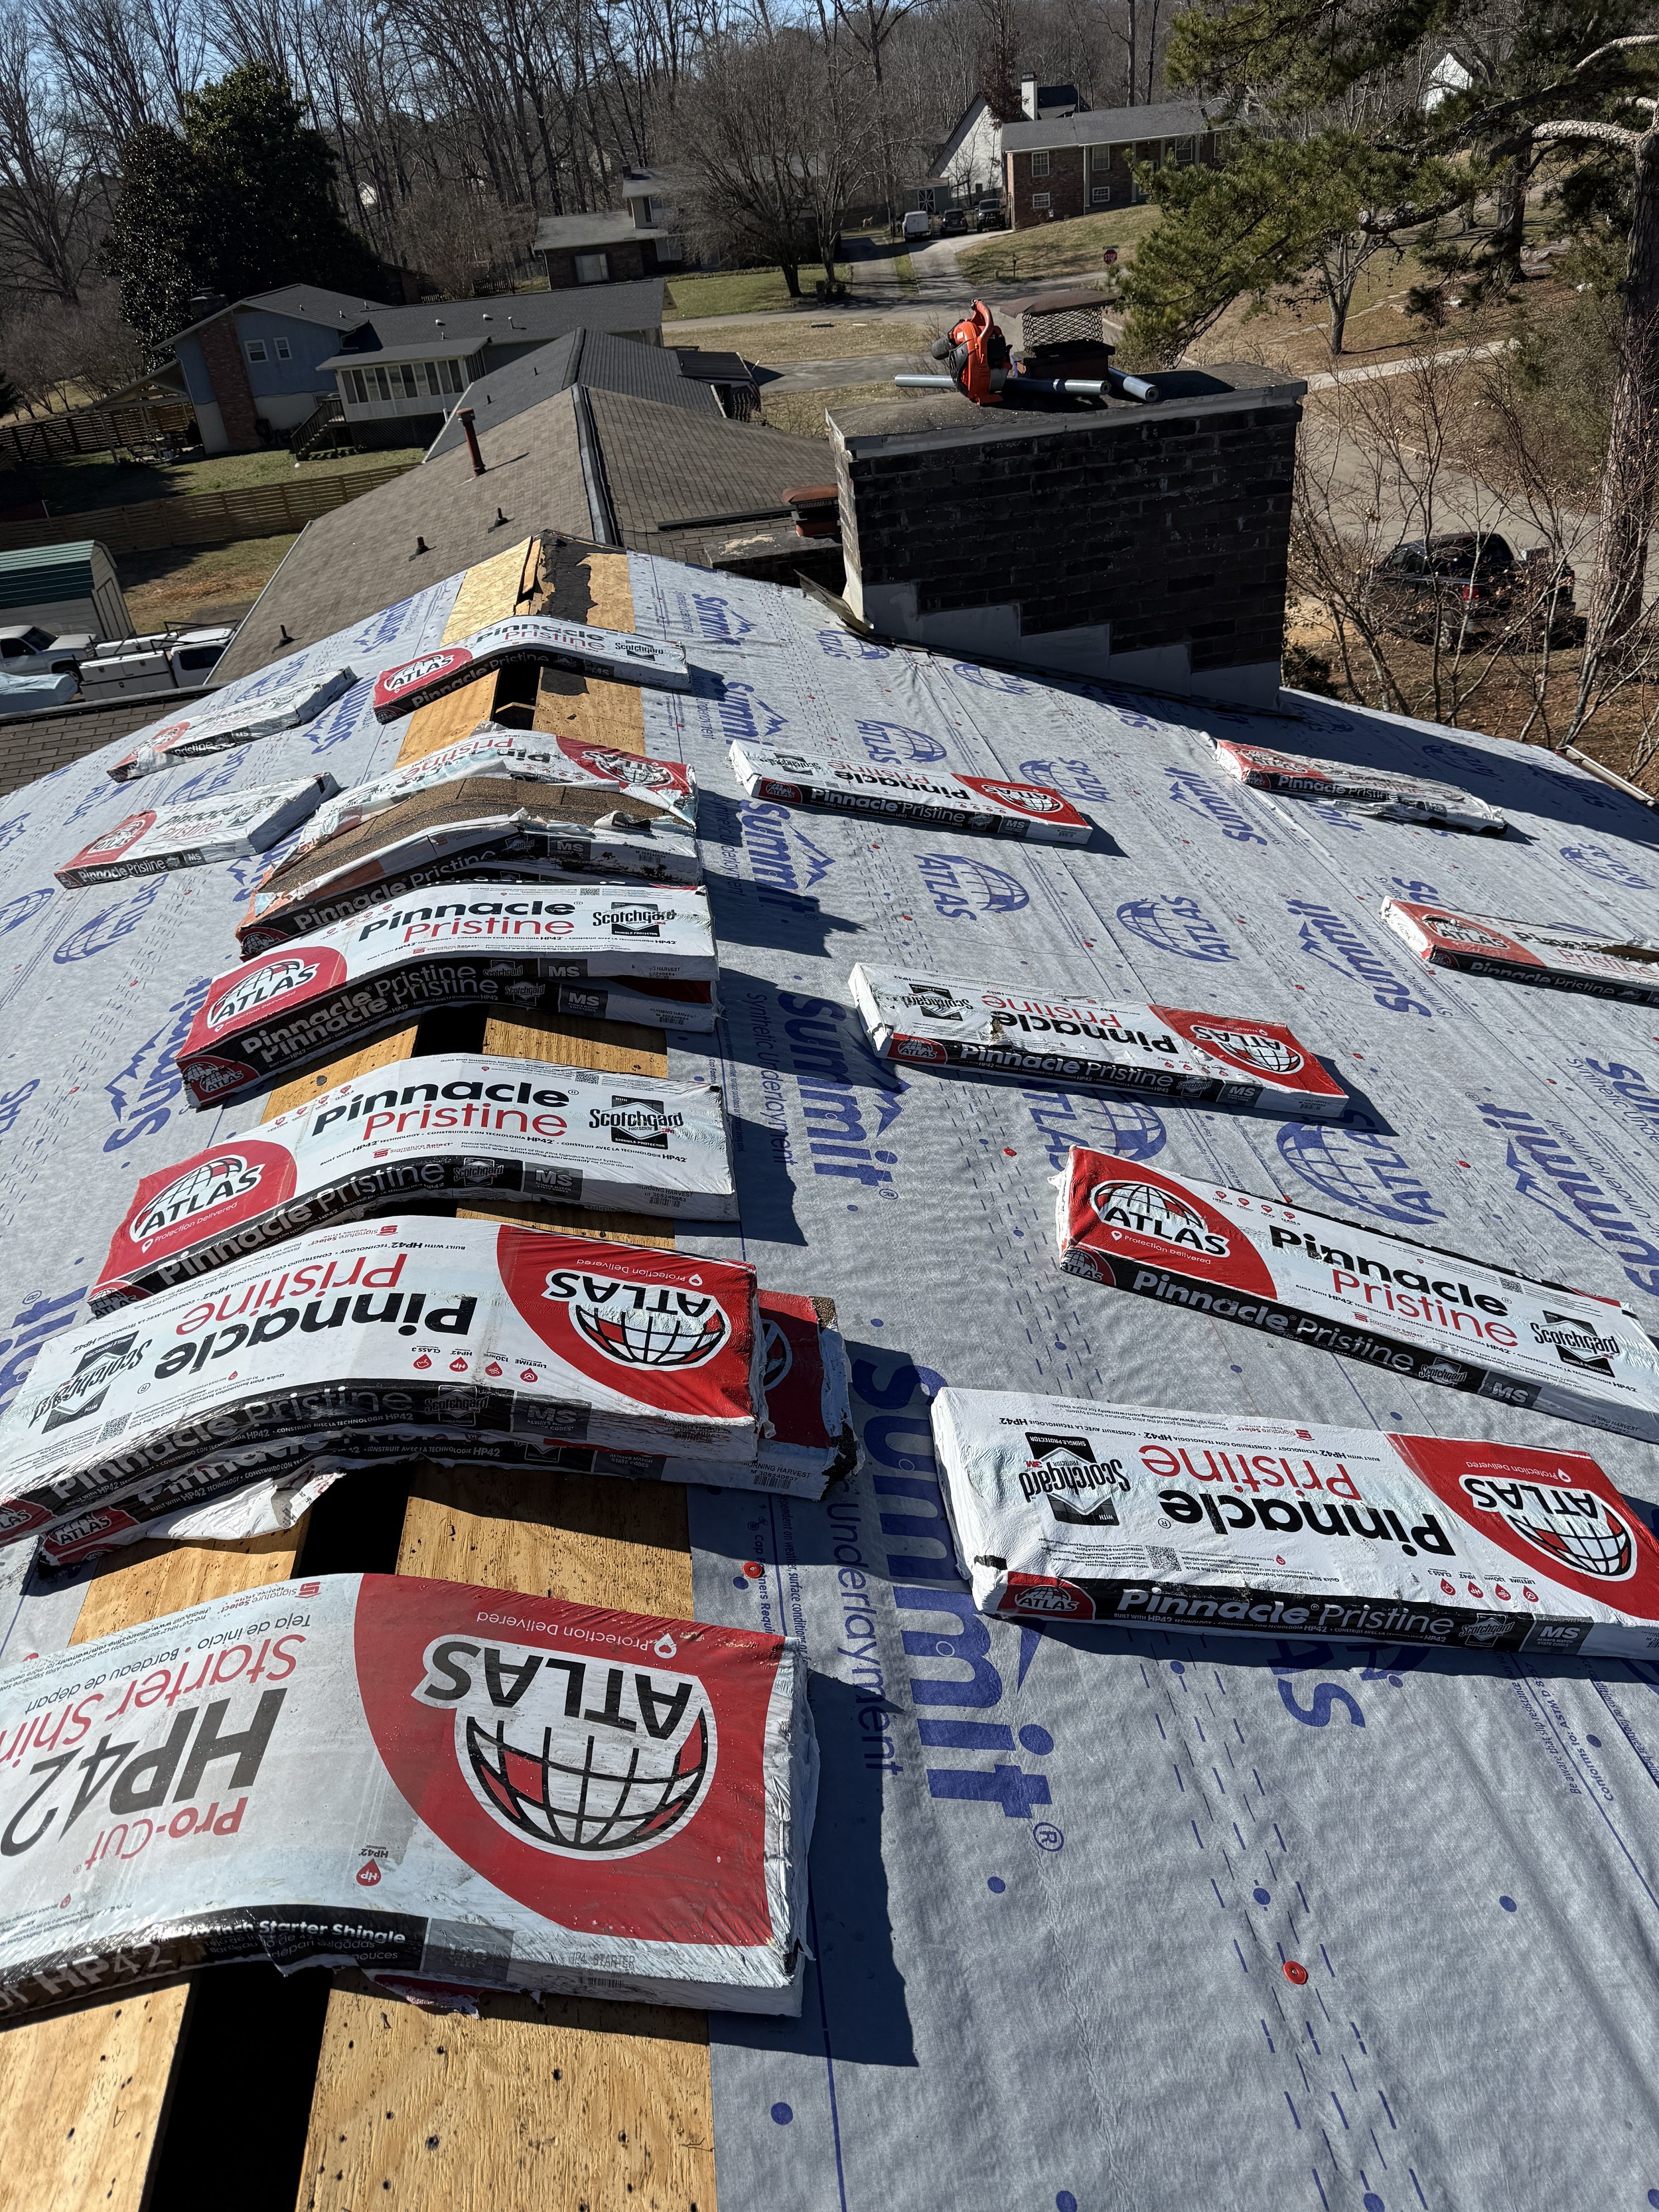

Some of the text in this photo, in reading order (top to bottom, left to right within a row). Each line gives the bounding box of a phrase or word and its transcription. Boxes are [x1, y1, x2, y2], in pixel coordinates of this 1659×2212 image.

[476, 623, 605, 644] Pinnacle
[504, 630, 605, 651] Pristine
[391, 656, 453, 692] ATLAS
[411, 667, 488, 708] Pinnacle
[175, 741, 213, 757] Pristine
[828, 761, 930, 784] Pristine
[834, 771, 970, 799] Pinnacle
[769, 786, 795, 797] ATLAS
[983, 784, 1050, 800] ATLAS
[1277, 775, 1398, 800] Pinnacle Pristine
[811, 787, 966, 823] Pinnacle Pristine
[1005, 820, 1025, 830] MS
[186, 853, 201, 862] MS
[556, 841, 585, 855] MS
[78, 859, 167, 882] Pinnacle Pristine
[294, 877, 407, 931] Pinnacle
[593, 909, 676, 926] Scotchgard
[358, 900, 576, 942] Pinnacle
[403, 916, 575, 942] Pristine
[1441, 930, 1508, 948] ATLAS
[547, 966, 580, 977] MS
[1286, 899, 1432, 1018] Summit
[1557, 948, 1659, 977] Pristine
[1470, 961, 1551, 985] Pinnacle
[212, 965, 317, 1023] ATLAS
[567, 992, 601, 1006] MS
[240, 964, 476, 1054] Pinnacle Pristine
[981, 995, 1123, 1029] Pristine
[990, 1010, 1179, 1055] Pinnacle
[1192, 1025, 1282, 1051] ATLAS
[899, 1045, 937, 1059] ATLAS
[961, 1047, 1173, 1087] Pinnacle Pristine
[207, 1072, 244, 1092] ATLAS
[776, 993, 895, 1187] Summit
[1228, 1086, 1256, 1097] MS
[312, 1081, 569, 1136] Pinnacle
[363, 1102, 568, 1141] Pristine
[589, 1109, 684, 1129] Scotchgard
[453, 1163, 504, 1181] Scotchgard
[536, 1169, 573, 1187] MS
[139, 1164, 266, 1238] ATLAS
[155, 1201, 238, 1242] Protection Delivered
[159, 1163, 445, 1285] Pinnacle Pristine
[1103, 1207, 1228, 1256] ATLAS
[1124, 1234, 1211, 1265] Protection Delivered
[576, 1258, 685, 1283] Protection Delivered
[1061, 1262, 1103, 1281] ATLAS
[1269, 1224, 1509, 1317] Pinnacle
[175, 1253, 407, 1336] Pristine
[549, 1271, 712, 1318] ATLAS
[1332, 1269, 1518, 1347] Pristine
[1133, 1270, 1415, 1372] Pinnacle Pristine
[154, 1293, 478, 1380] Pinnacle
[1530, 1322, 1621, 1355] Scotchgard
[1418, 1363, 1467, 1384] Scotchgard
[424, 1396, 490, 1415] Scotchgard
[1492, 1382, 1529, 1404] MS
[524, 1406, 579, 1423] MS
[1029, 1420, 1074, 1429] TECHNOLOGIE
[50, 1410, 237, 1500] Pinnacle
[245, 1390, 413, 1426] Pristine
[246, 1429, 270, 1439] HP42
[1030, 1436, 1087, 1447] SHINGLE PROTECTOR
[1144, 1432, 1172, 1441] HP42
[472, 1446, 500, 1457] HP42
[1319, 1449, 1346, 1459] HP42
[1019, 1458, 1130, 1503] Scotchgard
[1140, 1444, 1362, 1501] Pristine
[1466, 1461, 1559, 1479] Protection Delivered
[149, 1465, 280, 1512] BUILT WITH HP42 TECHNOLOGY CONSTRUIDO
[1463, 1477, 1599, 1519] ATLAS
[60, 1516, 110, 1545] ATLAS
[1158, 1489, 1457, 1557] Pinnacle
[222, 1589, 296, 1612] Signature Select
[788, 1573, 802, 1601] surface
[850, 1355, 1054, 1818] Summit
[1020, 1597, 1077, 1611] ATLAS
[1116, 1587, 1455, 1635] Pinnacle Pristine
[476, 1611, 650, 1651] Protection Delivered
[830, 1501, 903, 1776] Underlayment
[1459, 1622, 1514, 1637] Scotchgard
[1540, 1626, 1581, 1639] MS
[24, 1613, 311, 1716] Teja de inicio Bardeau de départ
[0, 1633, 308, 1770] Starter Shin
[423, 1640, 693, 1741] ATLAS
[1512, 1682, 1581, 1795] Be aware that slip resistance
[0, 1687, 288, 1857] HP42
[83, 1797, 249, 1871] Pro-Cut
[358, 1848, 389, 1858] HP42
[259, 1921, 328, 1935] Starter
[332, 1923, 405, 1943] Shingle
[35, 1941, 175, 1996] HP42
[593, 1954, 636, 1968] STARTER
